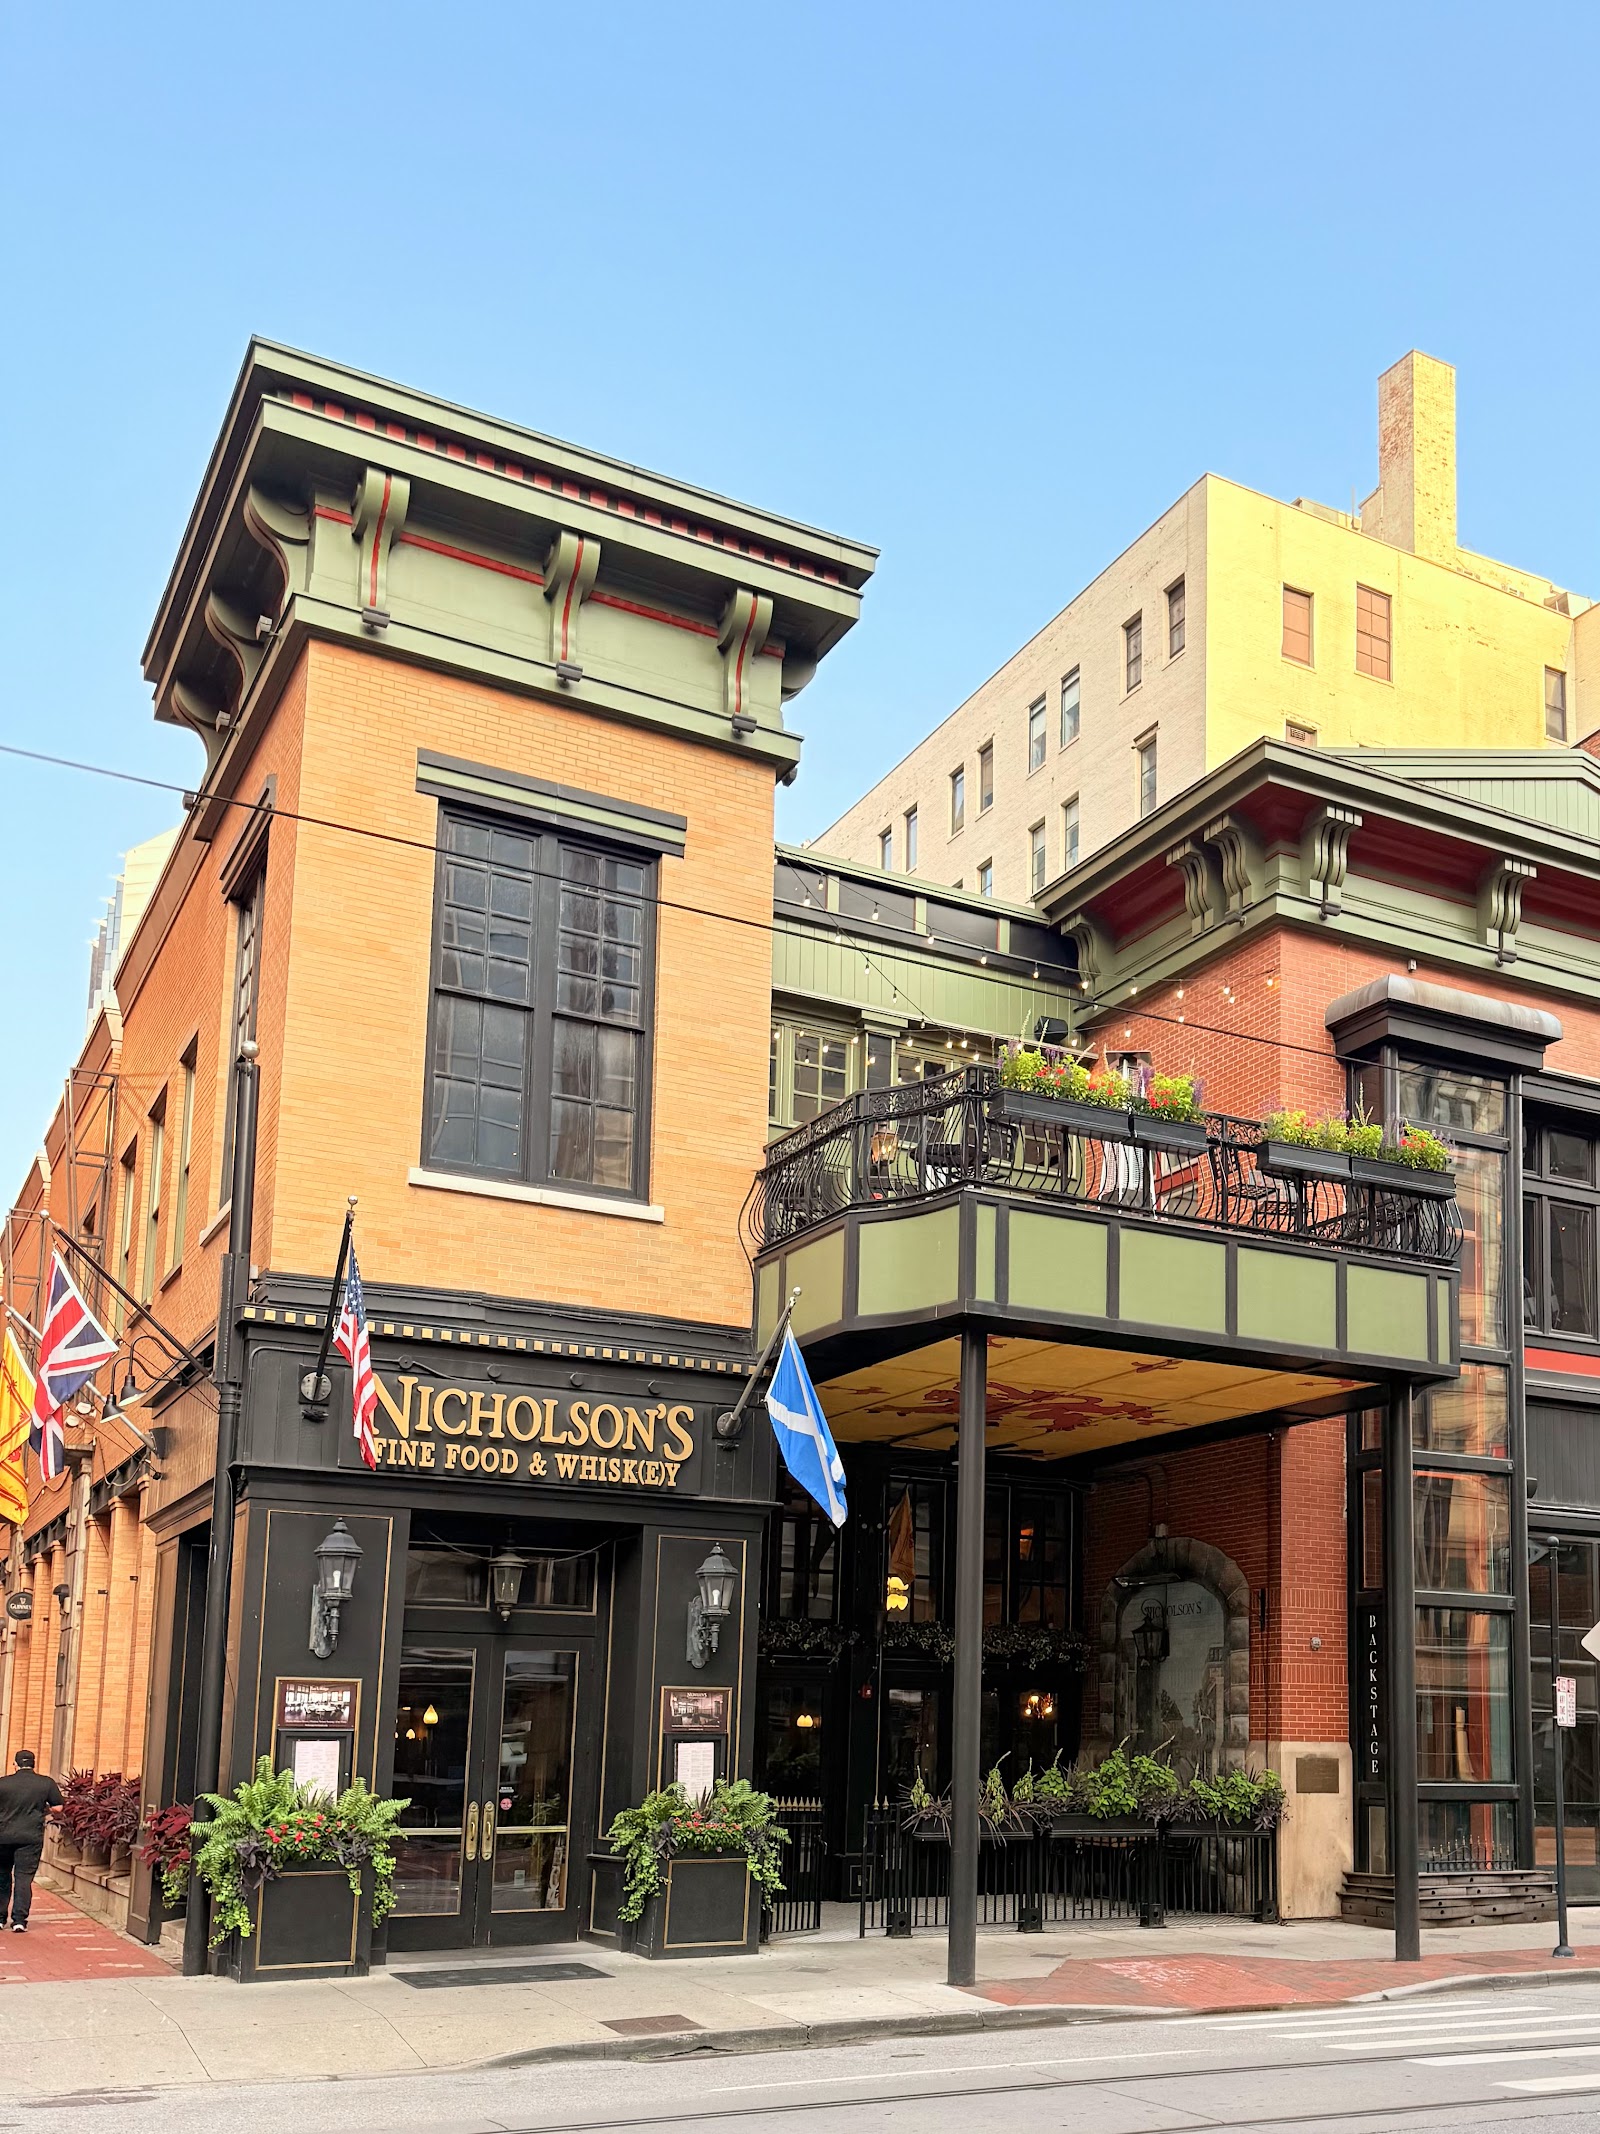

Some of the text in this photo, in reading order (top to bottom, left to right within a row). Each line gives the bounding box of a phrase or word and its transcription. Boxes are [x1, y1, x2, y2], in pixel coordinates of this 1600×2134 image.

[372, 1373, 694, 1462] NICHOLSON'S
[373, 1438, 681, 1487] FINE FOOD & WHISK(E)Y
[1144, 1601, 1202, 1619] NICOLSON'S
[1369, 1614, 1379, 1774] BACKSTAGE
